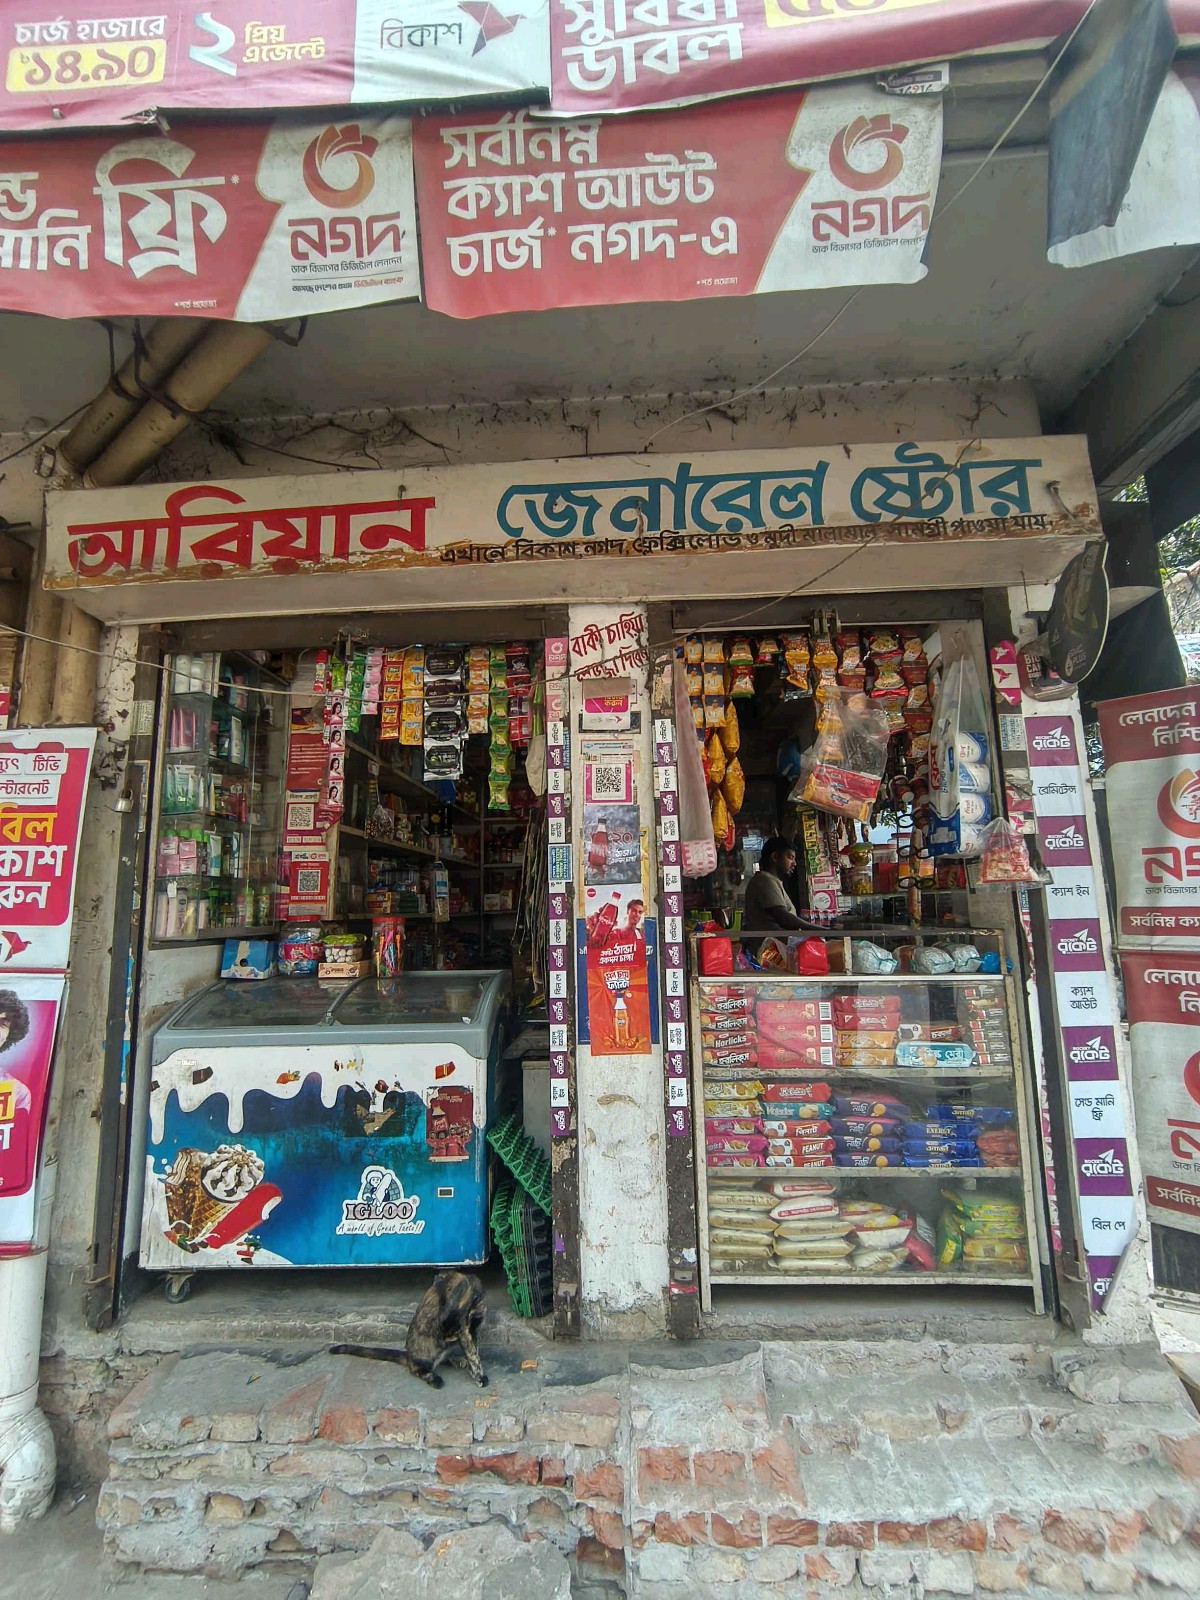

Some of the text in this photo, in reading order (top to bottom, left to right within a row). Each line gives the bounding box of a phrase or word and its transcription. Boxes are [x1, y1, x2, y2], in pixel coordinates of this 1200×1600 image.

[14, 15, 168, 44] চার্জ হাজারে
[245, 22, 287, 46] প্রিয়
[379, 17, 464, 50] বিকাশ
[189, 11, 239, 77] ২
[242, 37, 327, 63] এজেন্টে
[562, 22, 744, 92] ডাবল
[443, 149, 718, 220] ক্যাশ আউট
[811, 191, 931, 242] নগদ
[288, 210, 402, 261] নগদ
[568, 215, 740, 265] নগদ-এ
[812, 245, 829, 255] ডাক
[830, 242, 862, 254] বিভাগের
[863, 237, 899, 250] ডিজিটাল
[291, 256, 403, 275] ডাক বিভাগের ডিজিটাল লেনদেন
[496, 441, 1043, 538] জেনারেল ষ্টোর
[1119, 701, 1197, 727] লেনদেন
[32, 754, 61, 772] টিভি
[1051, 884, 1090, 897] ক্যাশ ইন
[1145, 884, 1198, 895] ডাক বিভাগের
[1129, 912, 1177, 928] সর্বনিম্ন
[1070, 986, 1094, 997] ক্যাশ
[1070, 998, 1098, 1010] আউট
[715, 1034, 747, 1048] Horlicks
[1075, 1093, 1115, 1107] সেন্ড মানি
[1092, 1107, 1104, 1121] ফ্রি
[801, 1142, 825, 1154] PEANUT
[1172, 1160, 1192, 1171] ডাক
[345, 1202, 414, 1221] IGLOO
[338, 1223, 345, 1232] A
[346, 1223, 366, 1232] world
[367, 1223, 374, 1235] of
[376, 1222, 396, 1234] Great
[1091, 1217, 1126, 1231] বিল পে
